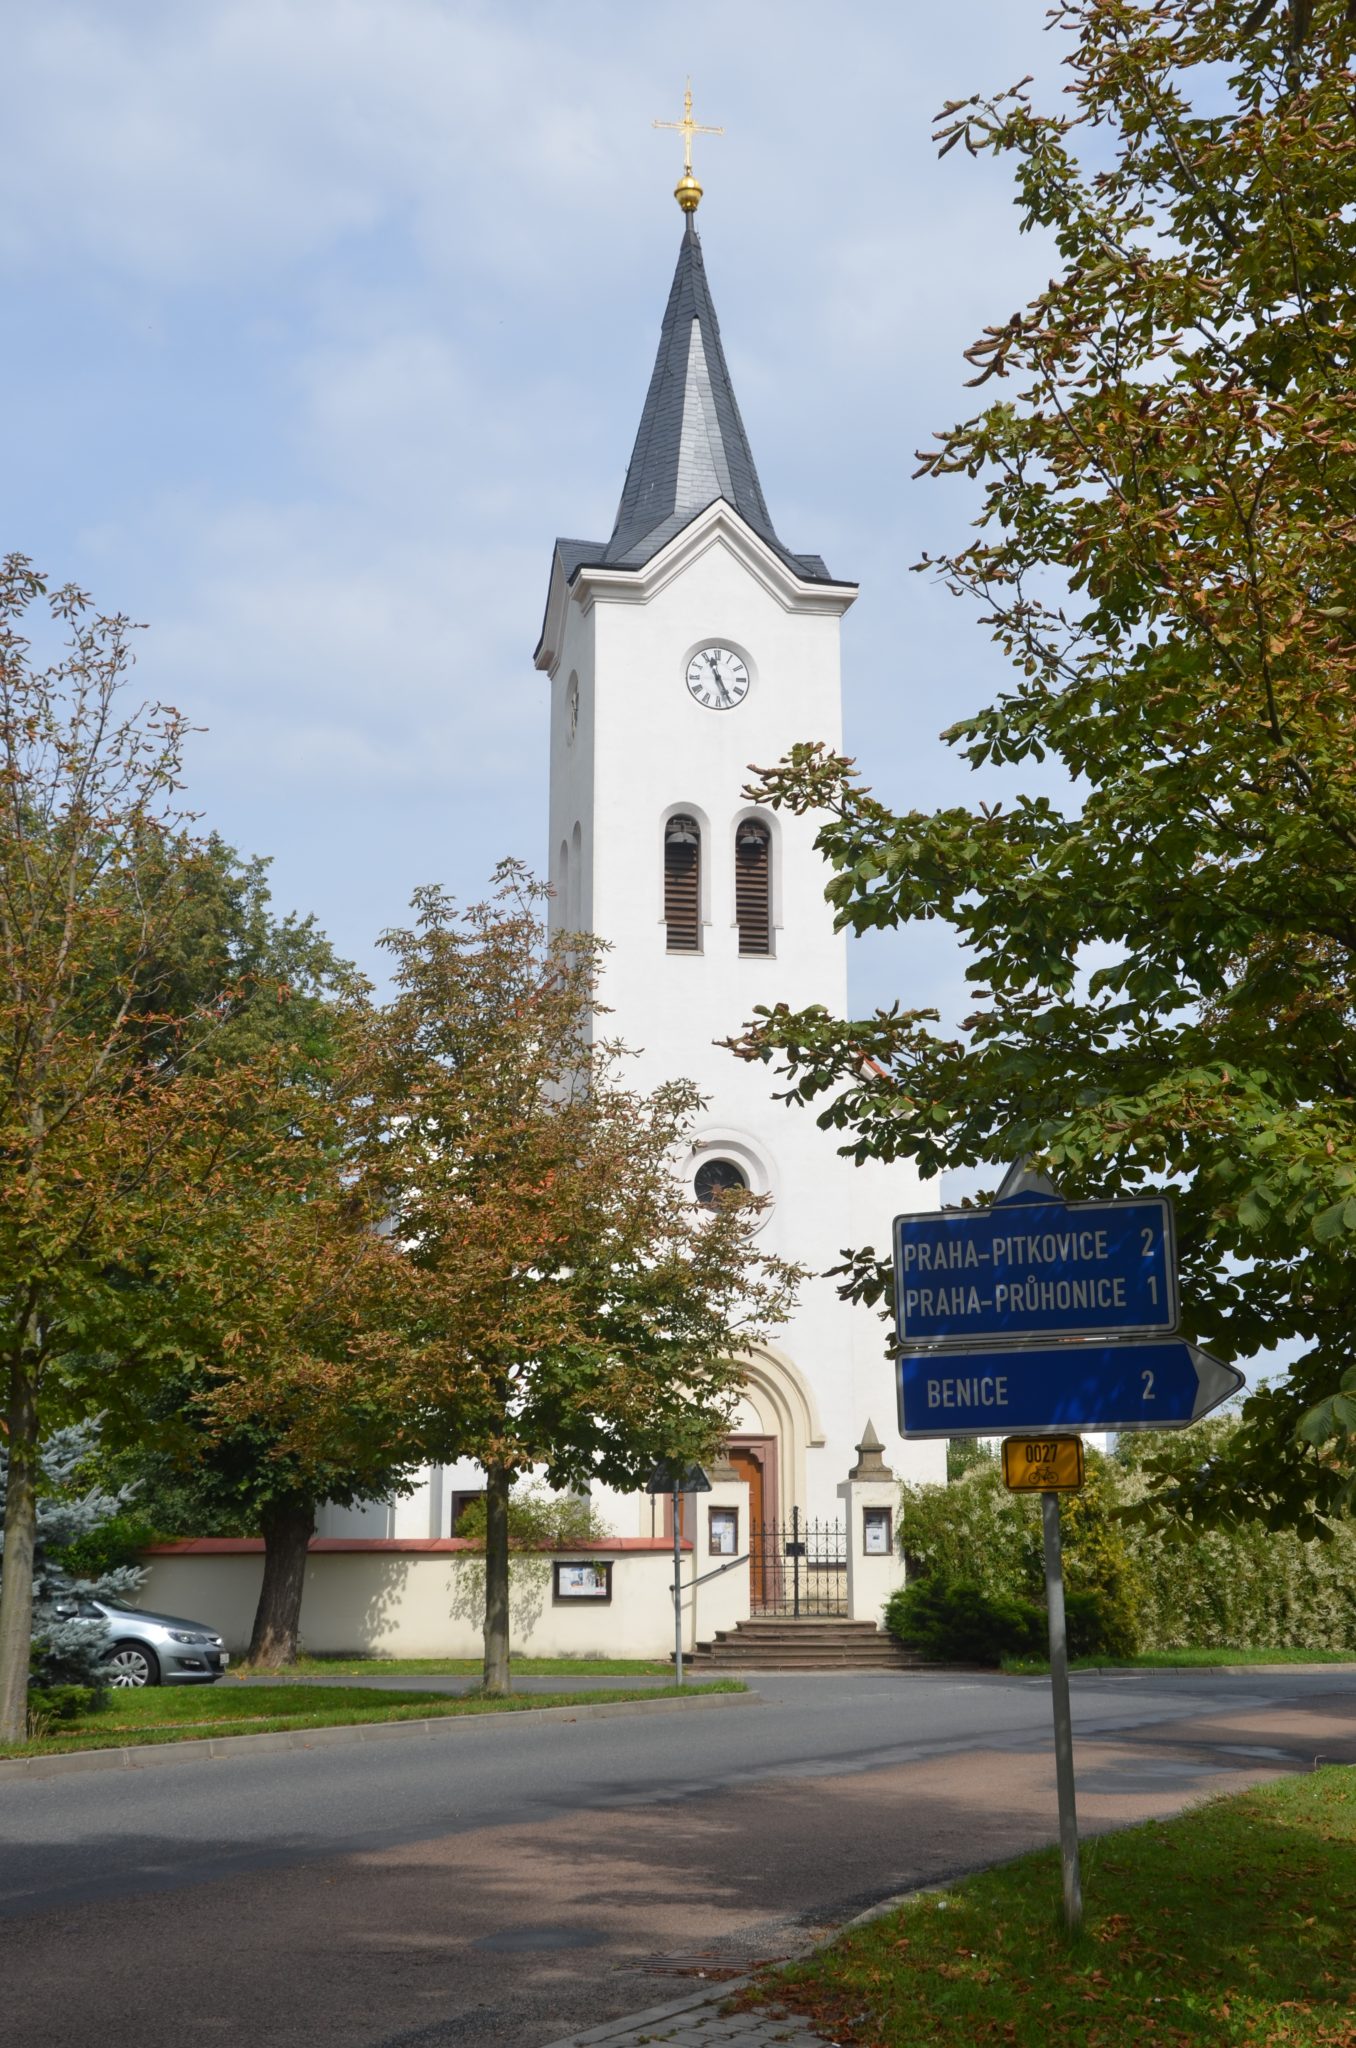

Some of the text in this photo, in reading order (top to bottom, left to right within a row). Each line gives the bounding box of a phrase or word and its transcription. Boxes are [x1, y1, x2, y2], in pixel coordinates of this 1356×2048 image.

[904, 1228, 1155, 1272] PRAHA-PITKOVICE 2
[906, 1275, 1159, 1317] PRAHA-PRŮHONICE 1
[927, 1370, 1156, 1408] BENICE 2
[1025, 1444, 1058, 1463] 0027
